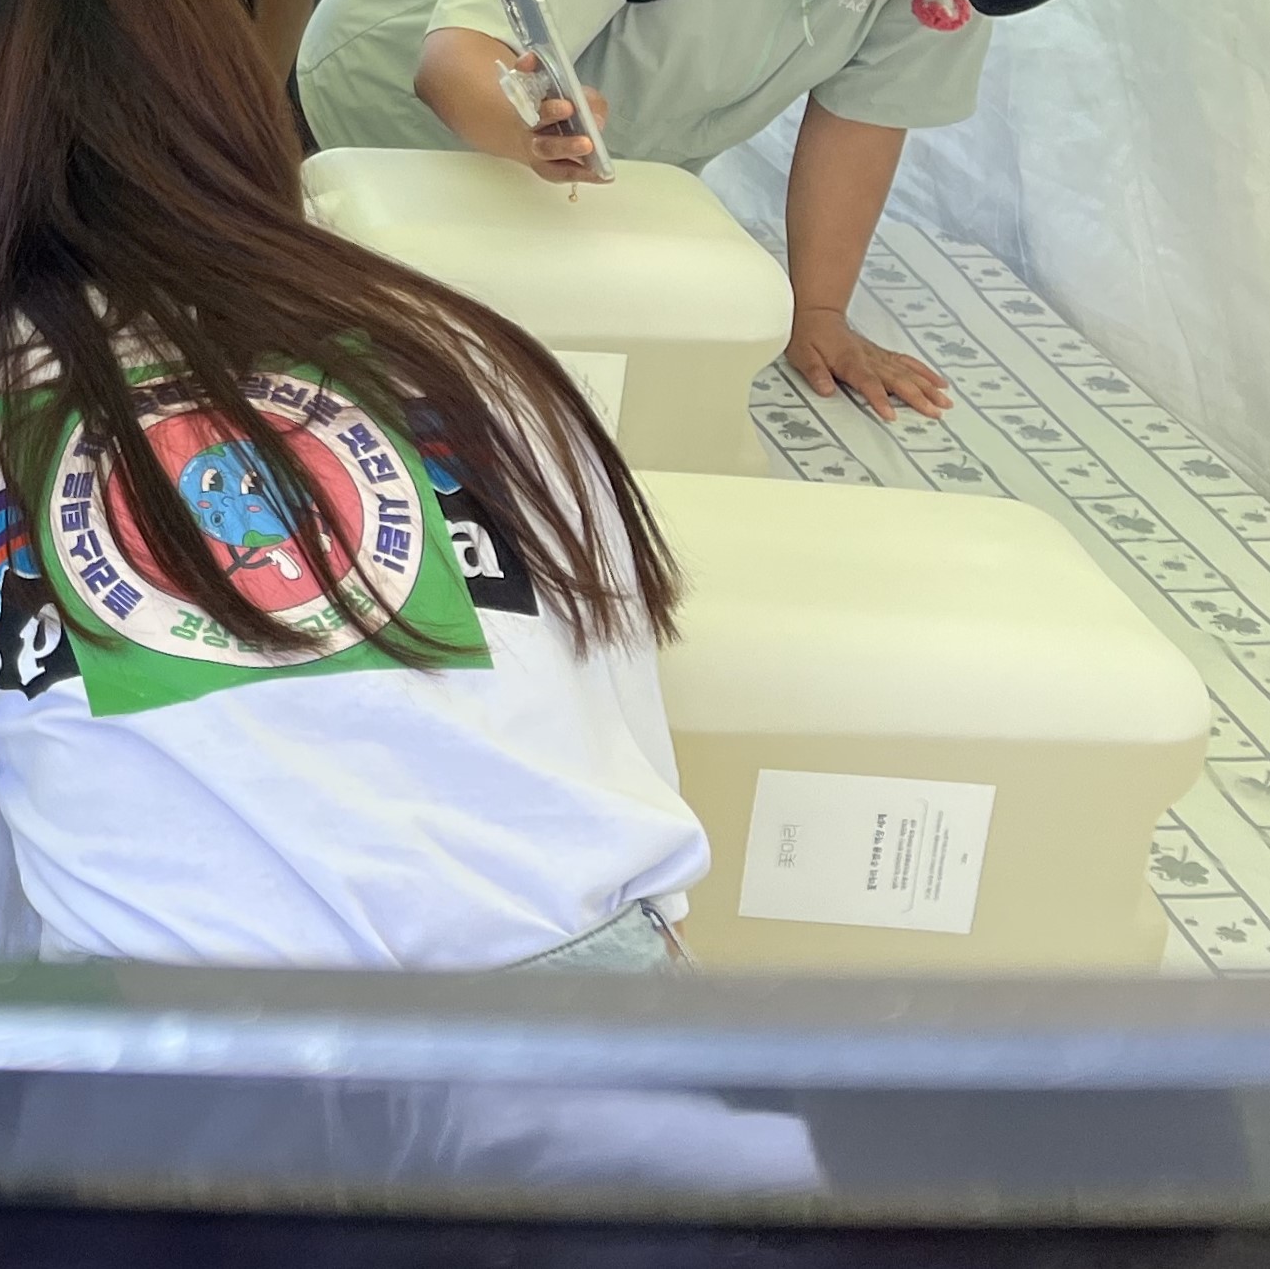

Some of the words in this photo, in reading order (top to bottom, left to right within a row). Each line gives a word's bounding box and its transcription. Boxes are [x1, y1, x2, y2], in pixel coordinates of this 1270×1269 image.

[60, 472, 145, 621] 플라스틱을
[337, 422, 401, 485] 멋진
[372, 493, 412, 575] 사람!
